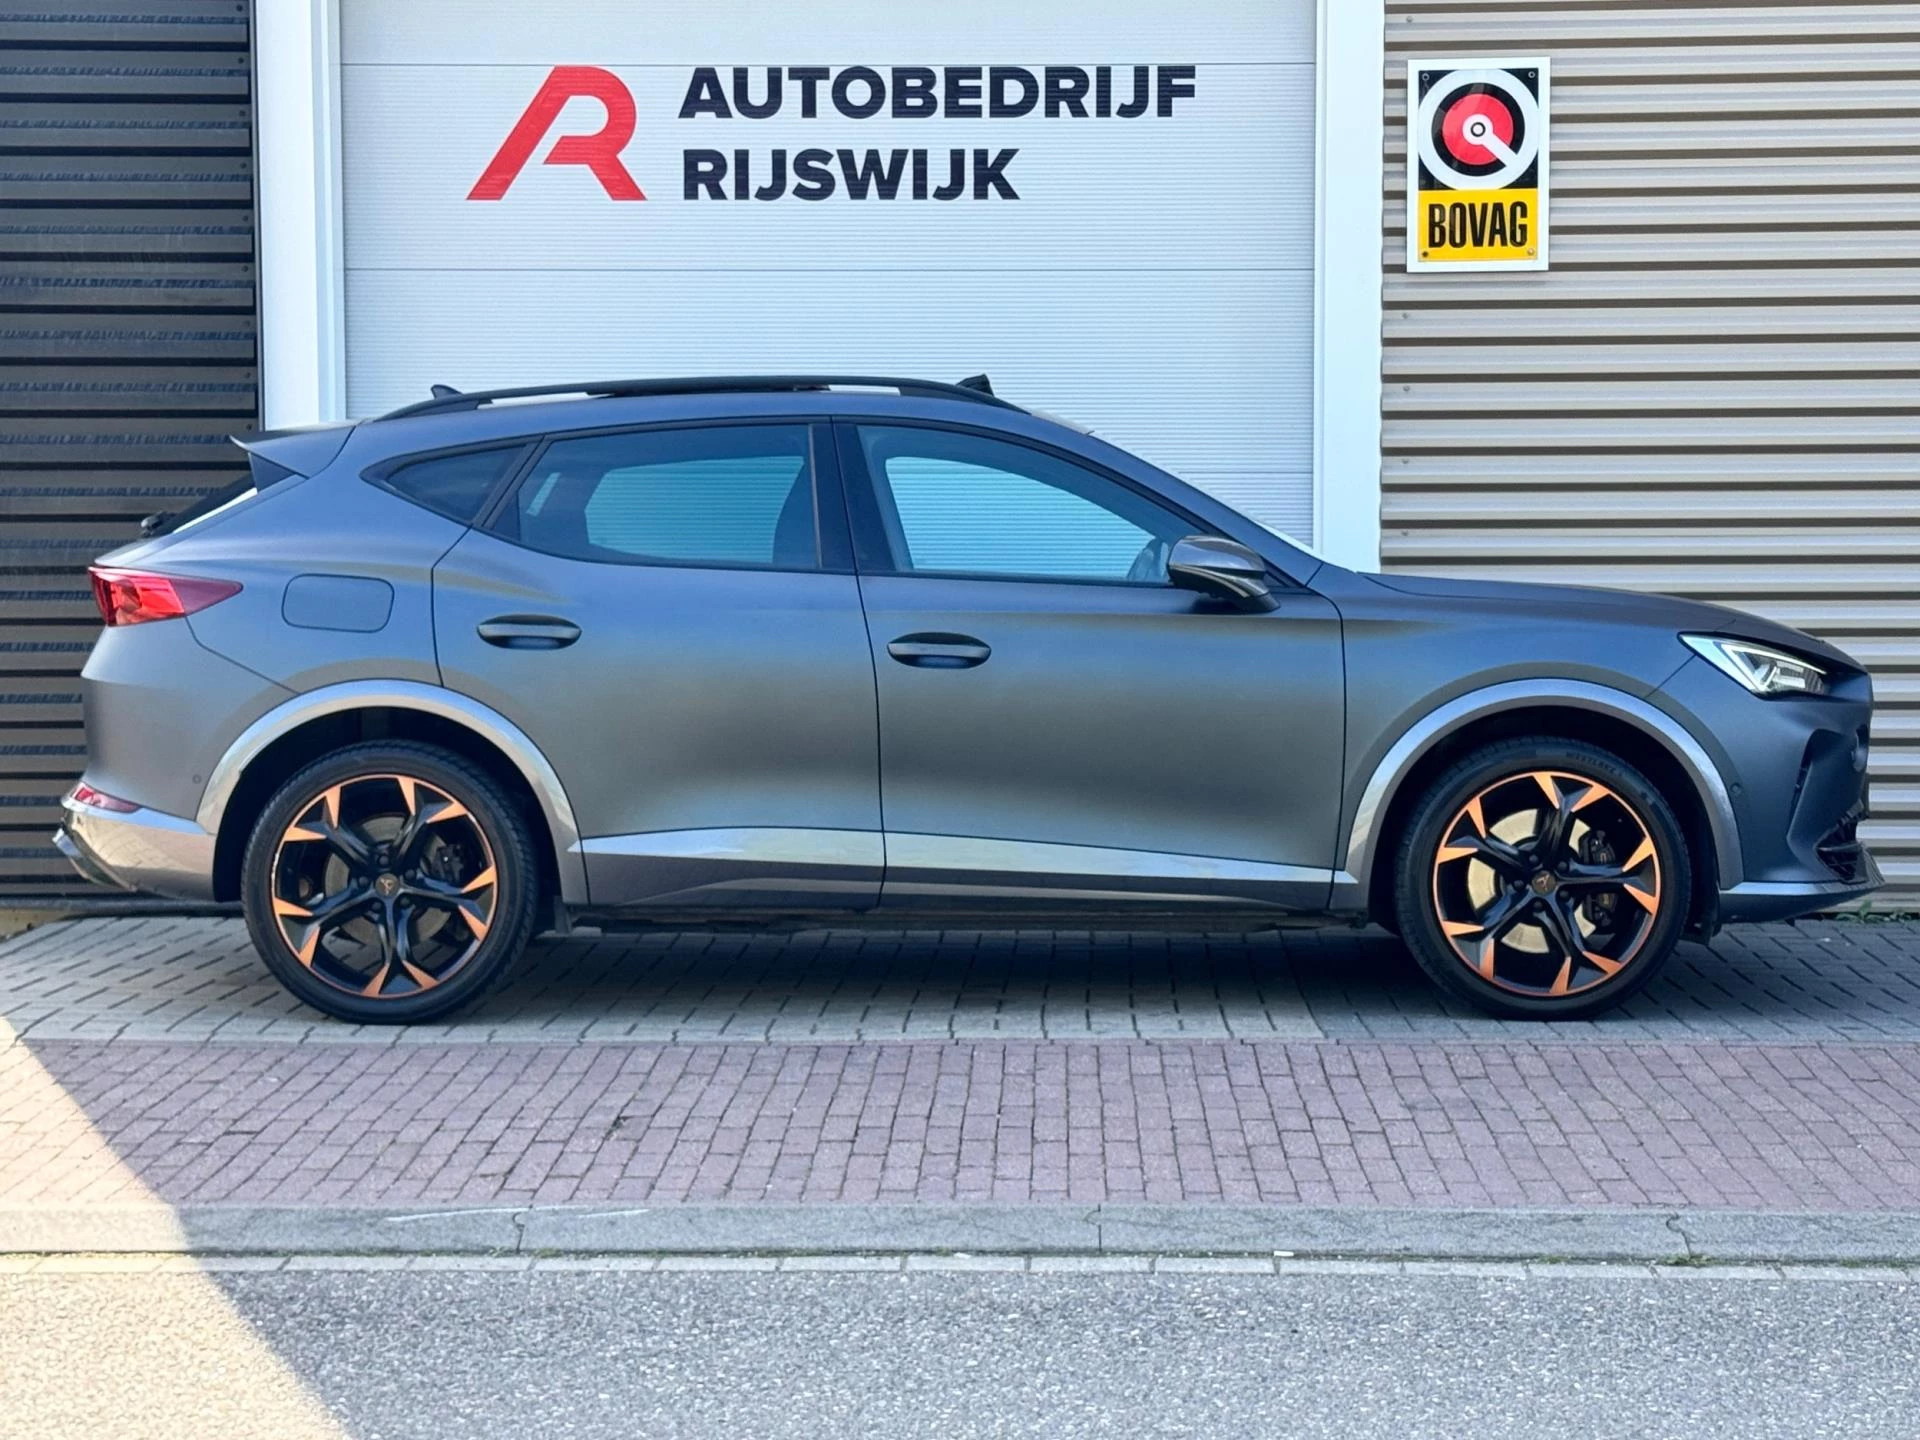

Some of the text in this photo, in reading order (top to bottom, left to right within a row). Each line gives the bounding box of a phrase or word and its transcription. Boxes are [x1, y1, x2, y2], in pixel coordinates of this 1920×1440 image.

[678, 65, 1196, 119] AUTOBEDRIJF
[683, 148, 1020, 201] RIJSWIJK
[1428, 201, 1528, 248] BOVAG
